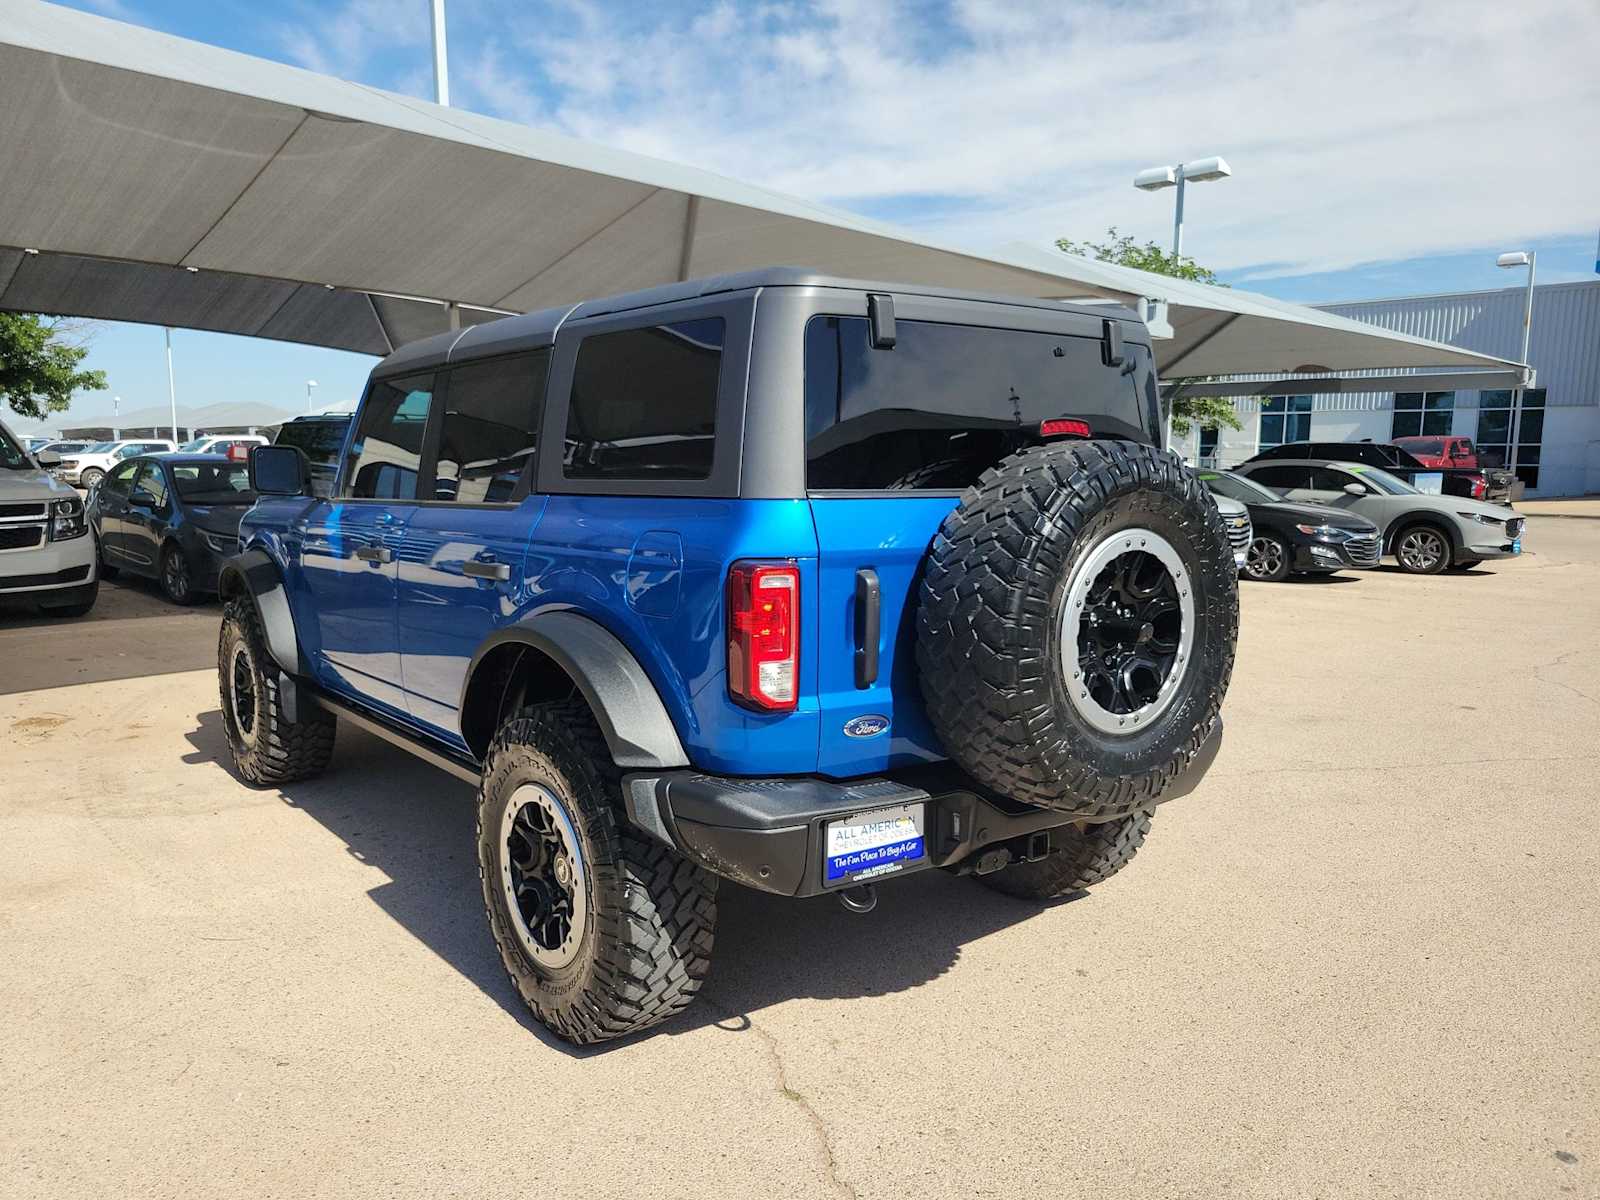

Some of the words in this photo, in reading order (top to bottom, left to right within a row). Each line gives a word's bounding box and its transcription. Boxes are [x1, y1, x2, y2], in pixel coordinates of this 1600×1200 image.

[855, 720, 881, 735] Ford
[836, 828, 856, 840] ALL
[861, 816, 915, 834] AMERICN
[834, 858, 847, 868] The
[847, 854, 860, 865] Fun
[860, 851, 878, 862] Place
[878, 848, 887, 858] To
[887, 846, 899, 858] Buy
[899, 844, 906, 852] A
[906, 842, 918, 851] Car
